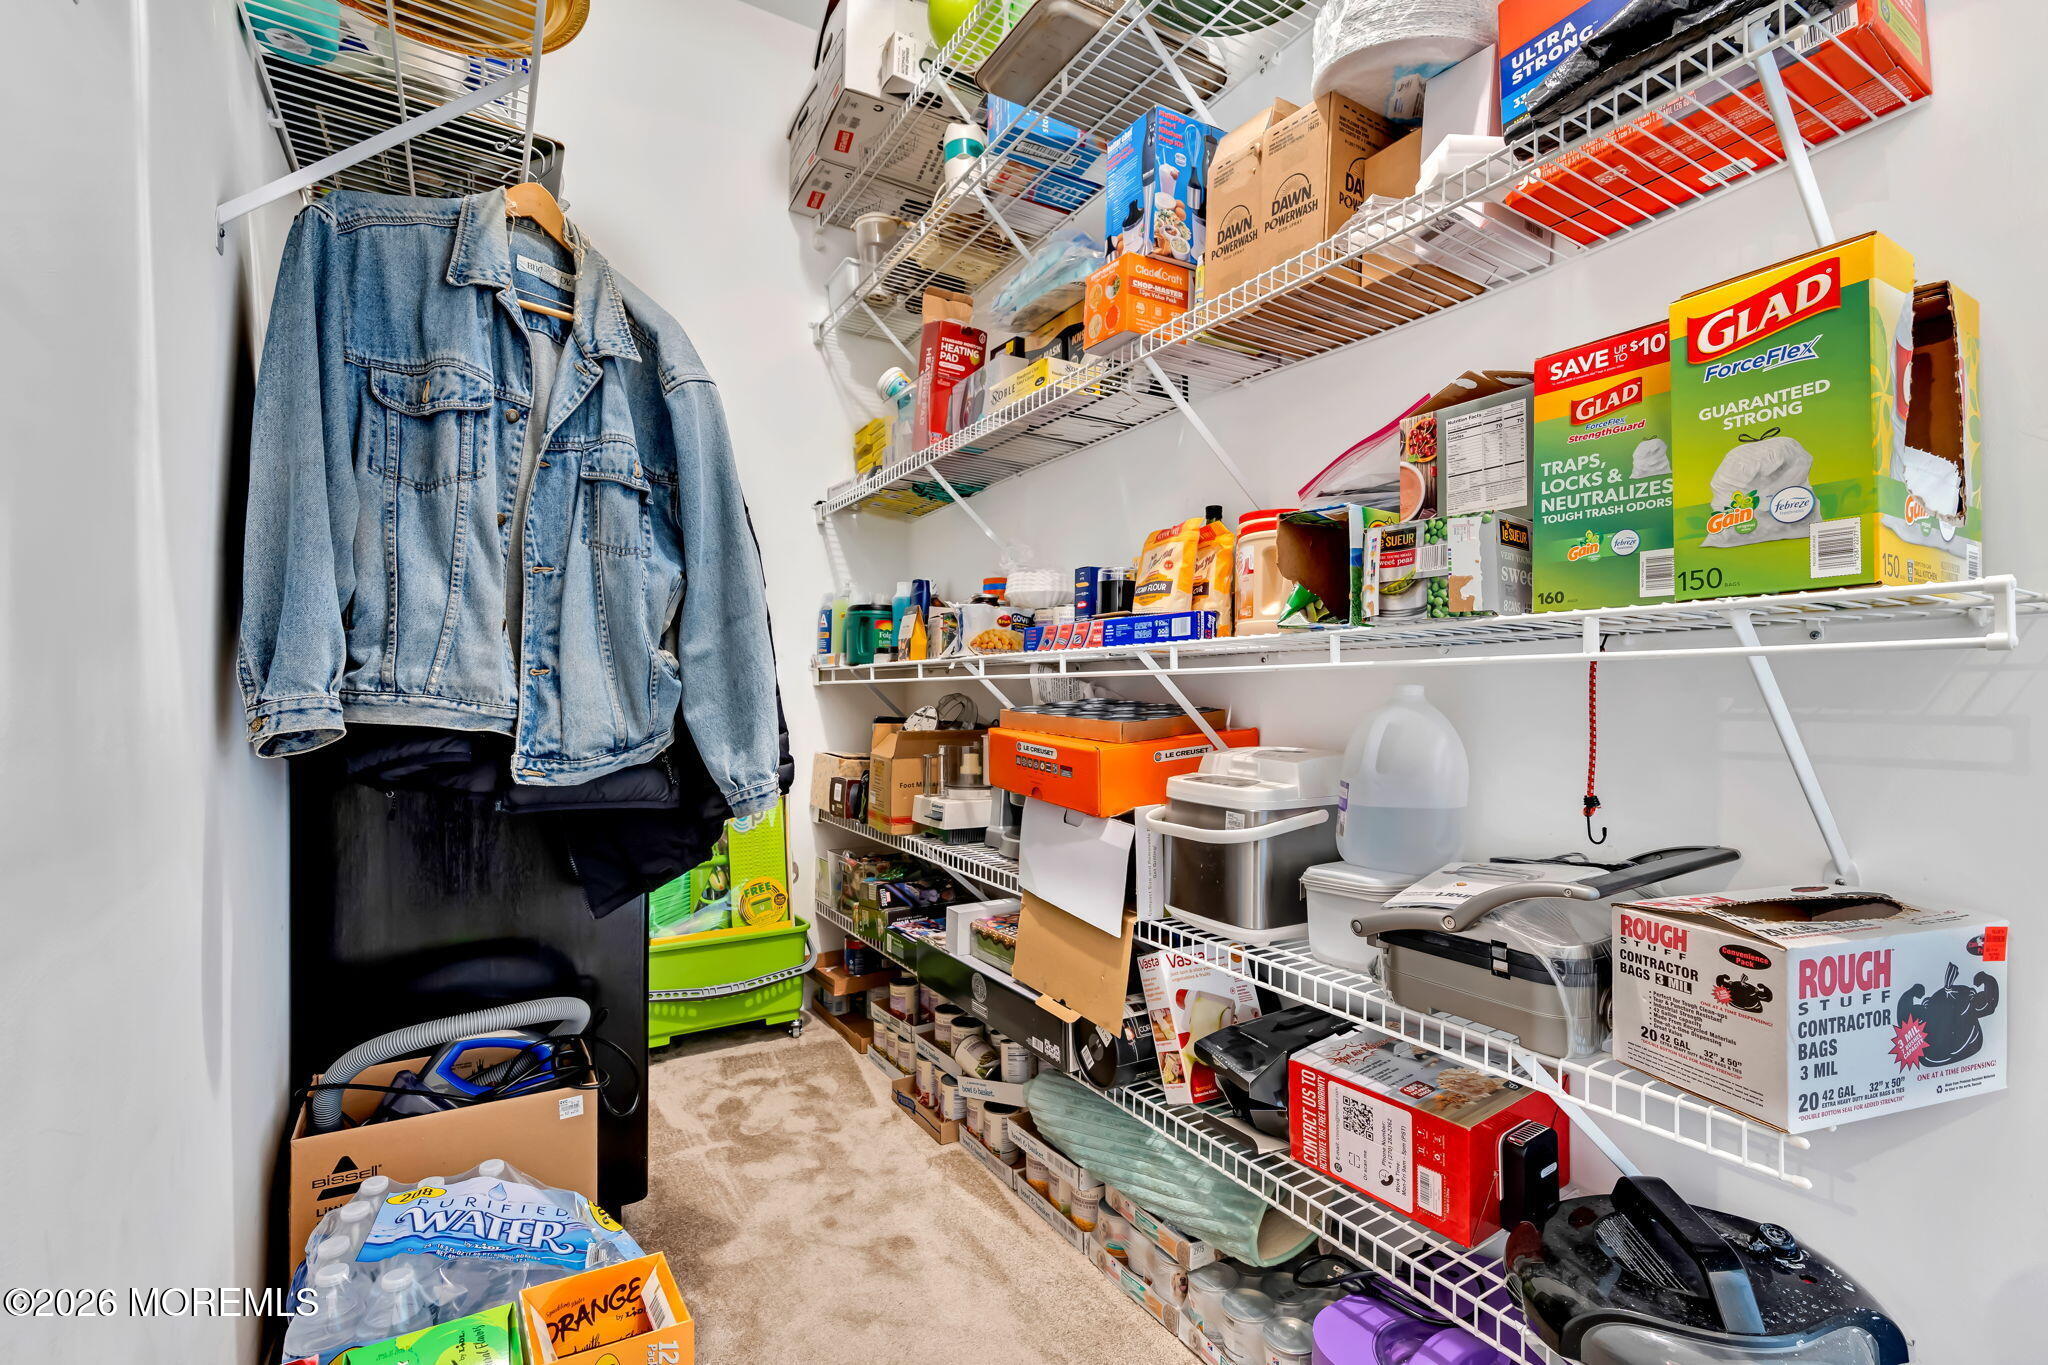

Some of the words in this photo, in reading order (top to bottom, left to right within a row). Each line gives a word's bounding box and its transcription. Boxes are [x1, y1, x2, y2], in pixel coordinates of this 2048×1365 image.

[1511, 22, 1576, 69] ULTRA
[1512, 25, 1593, 85] STRONG
[1345, 172, 1364, 195] DA
[1271, 183, 1312, 216] DAWN
[1264, 199, 1319, 233] POWERWASH
[1217, 215, 1253, 245] DAWN
[1211, 229, 1258, 261] POWERWASH
[1132, 279, 1184, 298] CHOP-MASTER
[1697, 272, 1833, 355] GLAD
[940, 342, 980, 358] HEATING
[940, 351, 959, 362] PAD
[1614, 344, 1628, 355] UP
[1614, 352, 1628, 363] TO
[1704, 335, 1823, 383] ForceFlex
[1549, 349, 1609, 381] SAVE
[1576, 384, 1639, 420] GLAD
[1698, 379, 1831, 421] GUARANTEED
[1723, 401, 1803, 430] STRONG
[1568, 420, 1646, 444] StrengthGuard
[1541, 453, 1606, 477] TRAPS,
[1541, 472, 1602, 495] LOCKS
[1607, 469, 1622, 483] &
[1541, 478, 1673, 513] NEUTRALIZES
[1775, 499, 1810, 514] febreze
[1542, 512, 1583, 525] TOUGH
[1585, 505, 1624, 518] TRASH
[1626, 497, 1673, 512] ODORS
[1706, 507, 1754, 534] Gain
[1386, 533, 1415, 548] SUEUR
[1567, 543, 1600, 562] Gain
[1883, 553, 1900, 578] 150
[1678, 568, 1723, 592] 150
[1538, 592, 1565, 605] 160
[1176, 747, 1208, 757] CREUSET
[743, 881, 772, 898] FREE
[1621, 914, 1688, 952] ROUGH
[1620, 937, 1686, 960] STUFF
[1722, 947, 1769, 965] Convenience
[1139, 957, 1160, 969] Vasta
[1620, 949, 1699, 982] CONTRACTOR
[1736, 957, 1754, 968] Pack
[1798, 949, 1892, 1000] ROUGH
[1620, 962, 1650, 981] BAGS
[1668, 976, 1692, 994] MIL
[1798, 990, 1891, 1015] STUFF
[1798, 1009, 1891, 1039] CONTRACTOR
[1640, 1025, 1658, 1042] 20
[1660, 1033, 1671, 1044] 42
[1673, 1038, 1691, 1051] GAL
[1898, 1040, 1904, 1049] 3
[1904, 1025, 1920, 1043] MIL
[1903, 1039, 1924, 1059] CAPACITY
[1798, 1039, 1838, 1060] BAGS
[1302, 1069, 1316, 1087] TO
[1800, 1065, 1808, 1080] 3
[1813, 1060, 1838, 1079] MIL
[1917, 1072, 1930, 1081] ONE
[1931, 1070, 1938, 1078] AT
[1945, 1066, 1959, 1076] TIME
[1302, 1088, 1317, 1105] US
[1798, 1092, 1819, 1113] 20
[1822, 1089, 1835, 1101] 42
[1838, 1085, 1856, 1098] GAL
[1822, 1101, 1836, 1109] EXTRA
[1865, 1092, 1878, 1100] BLACK
[1318, 1112, 1327, 1126] FREE
[1821, 1109, 1841, 1117] BOTTOM
[1864, 1101, 1879, 1109] ADDED
[1302, 1107, 1318, 1166] CONTACT
[1318, 1126, 1327, 1141] THE
[1319, 1141, 1328, 1171] ACTIVATE
[417, 1197, 568, 1217] PURIFIED
[395, 1206, 575, 1255] WATER
[616, 1314, 623, 1322] by
[659, 1340, 680, 1365] 12
